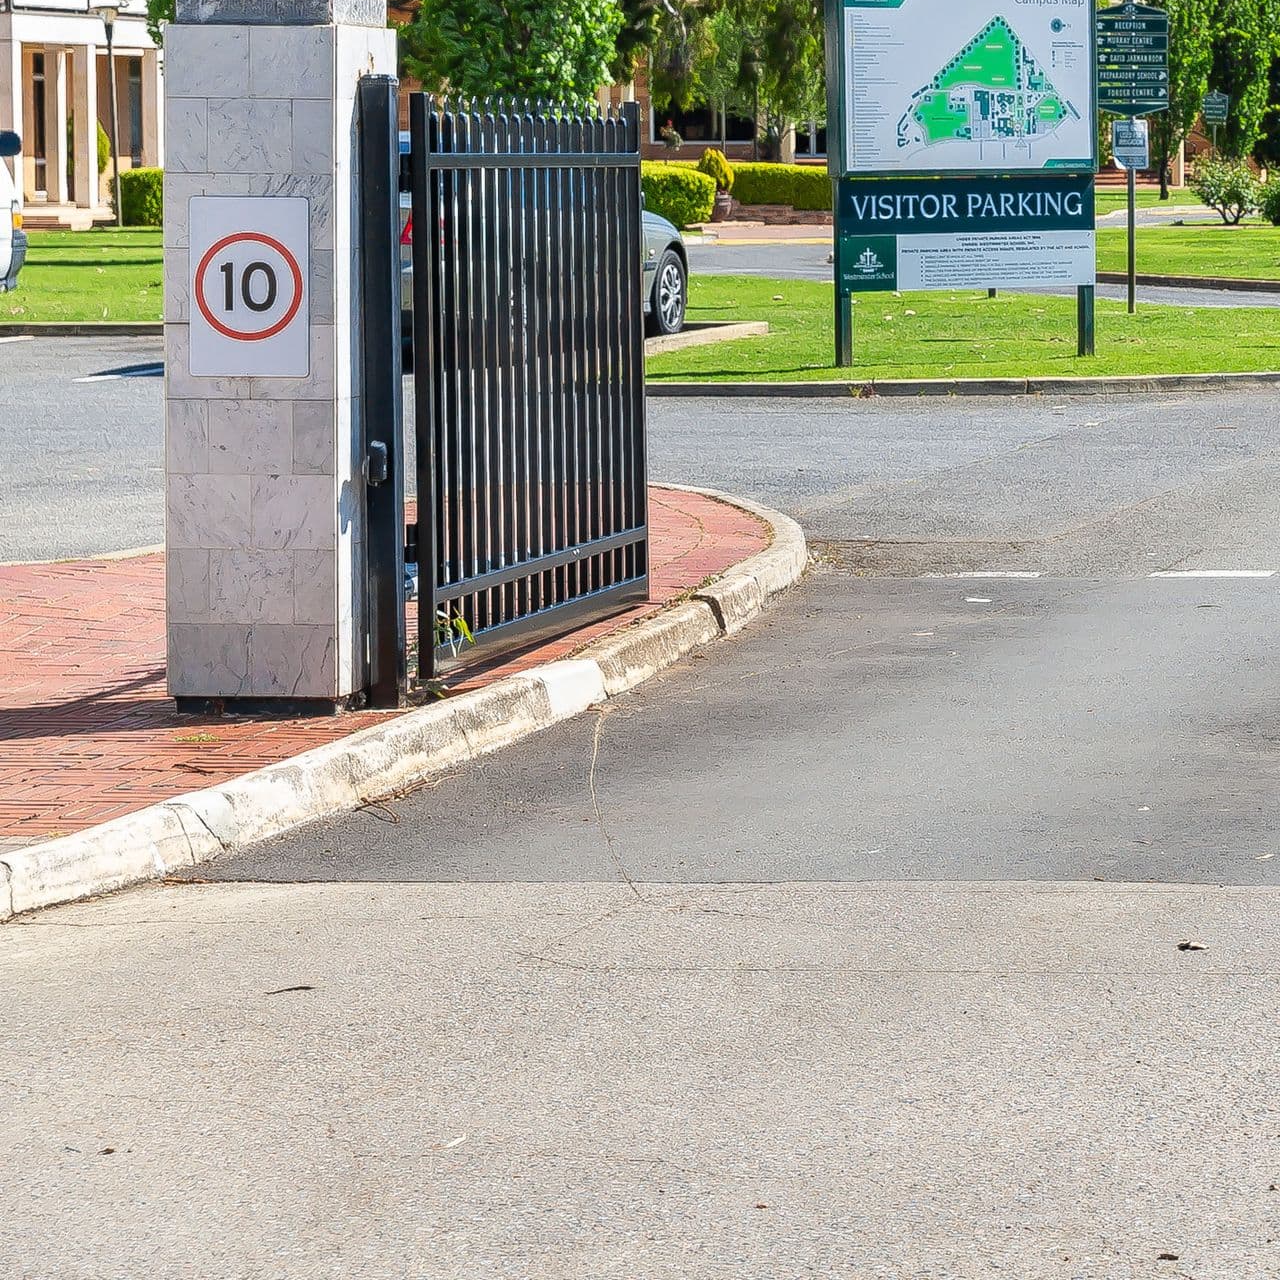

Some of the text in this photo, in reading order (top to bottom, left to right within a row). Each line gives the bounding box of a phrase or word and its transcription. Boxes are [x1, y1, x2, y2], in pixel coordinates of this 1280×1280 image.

[1114, 21, 1146, 30] RECEPTION
[1132, 36, 1153, 45] CENTRE
[1099, 71, 1158, 80] PREPARATORY SCHOOL
[1132, 88, 1154, 97] CENTRE
[851, 192, 1083, 220] VISITOR PARKING
[220, 261, 277, 312] 10
